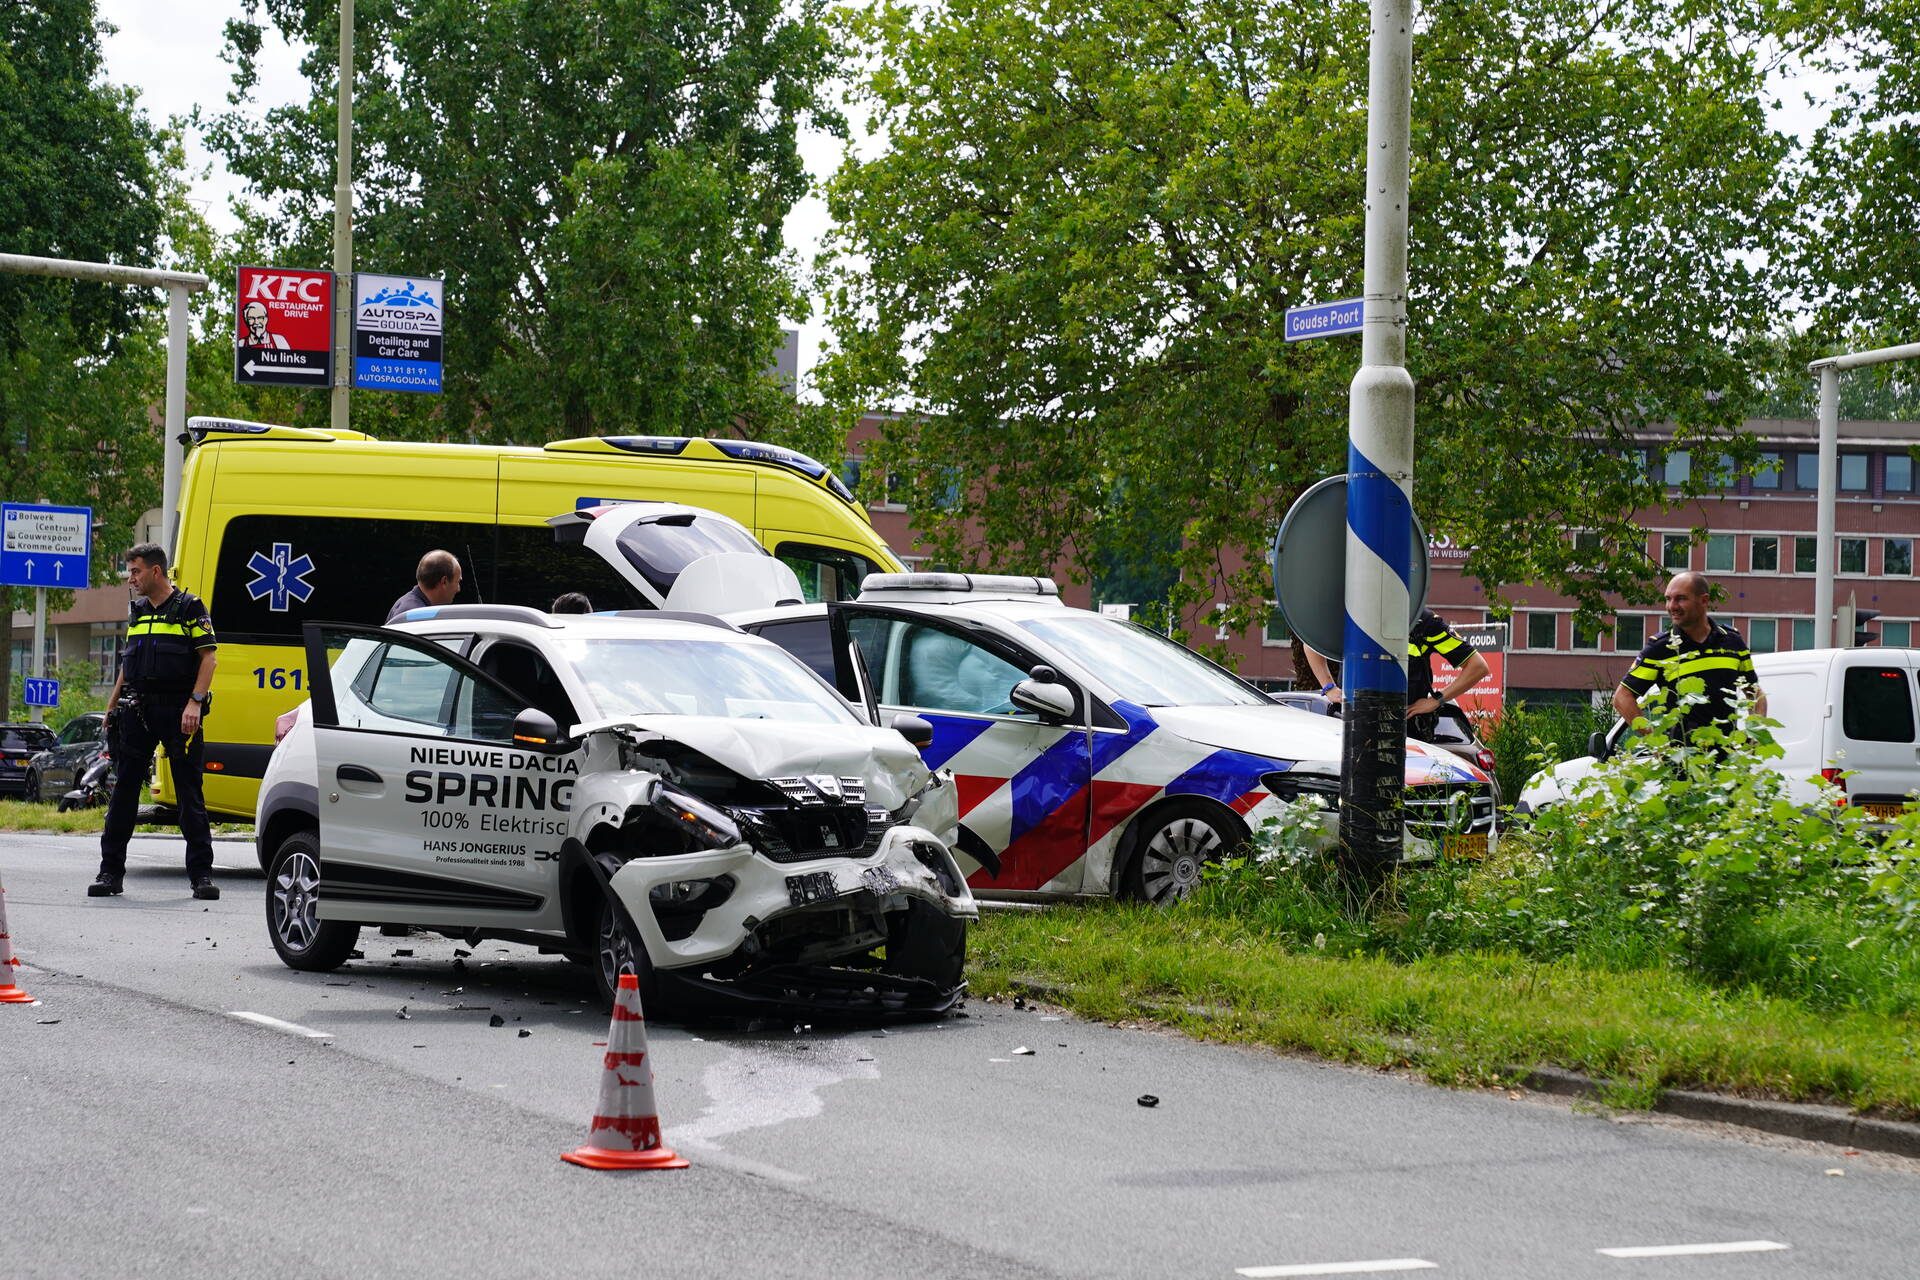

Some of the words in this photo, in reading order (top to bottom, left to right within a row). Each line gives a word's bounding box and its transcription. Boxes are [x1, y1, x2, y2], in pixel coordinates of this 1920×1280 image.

[246, 275, 323, 302] KFC
[268, 301, 324, 312] RESTAURANT
[284, 309, 309, 319] DRIVE
[363, 308, 436, 321] AUTOSPA
[1292, 315, 1329, 331] Goudse
[1330, 307, 1359, 326] Poort
[380, 319, 419, 331] GOUDA
[368, 335, 410, 349] Detailing
[412, 338, 430, 349] and
[260, 351, 278, 363] Nu
[279, 352, 307, 365] links
[378, 346, 396, 357] Car
[397, 347, 420, 358] Care
[370, 365, 380, 373] 06
[394, 366, 404, 374] 91
[407, 366, 416, 375] 81
[418, 367, 427, 375] 91
[358, 374, 439, 386] AUTOSPAGOUDA.NL
[19, 512, 54, 521] Bolwerk
[35, 522, 80, 534] (Centrum)
[18, 532, 72, 542] Gouwespoor
[17, 542, 53, 552] Kromme
[54, 543, 84, 553] Gouwe
[1469, 635, 1497, 646] GOUDA
[252, 667, 311, 691] 161
[410, 747, 503, 769] NIEUWE
[508, 754, 579, 775] DACIA
[405, 770, 576, 812] SPRING
[420, 810, 470, 829] 100%
[480, 813, 569, 836] Elektrisc
[423, 841, 457, 852] HANS
[458, 842, 526, 855] JONGERIUS
[435, 855, 489, 866] Professionaliteit
[490, 858, 507, 867] sinds
[508, 858, 525, 867] 1988
